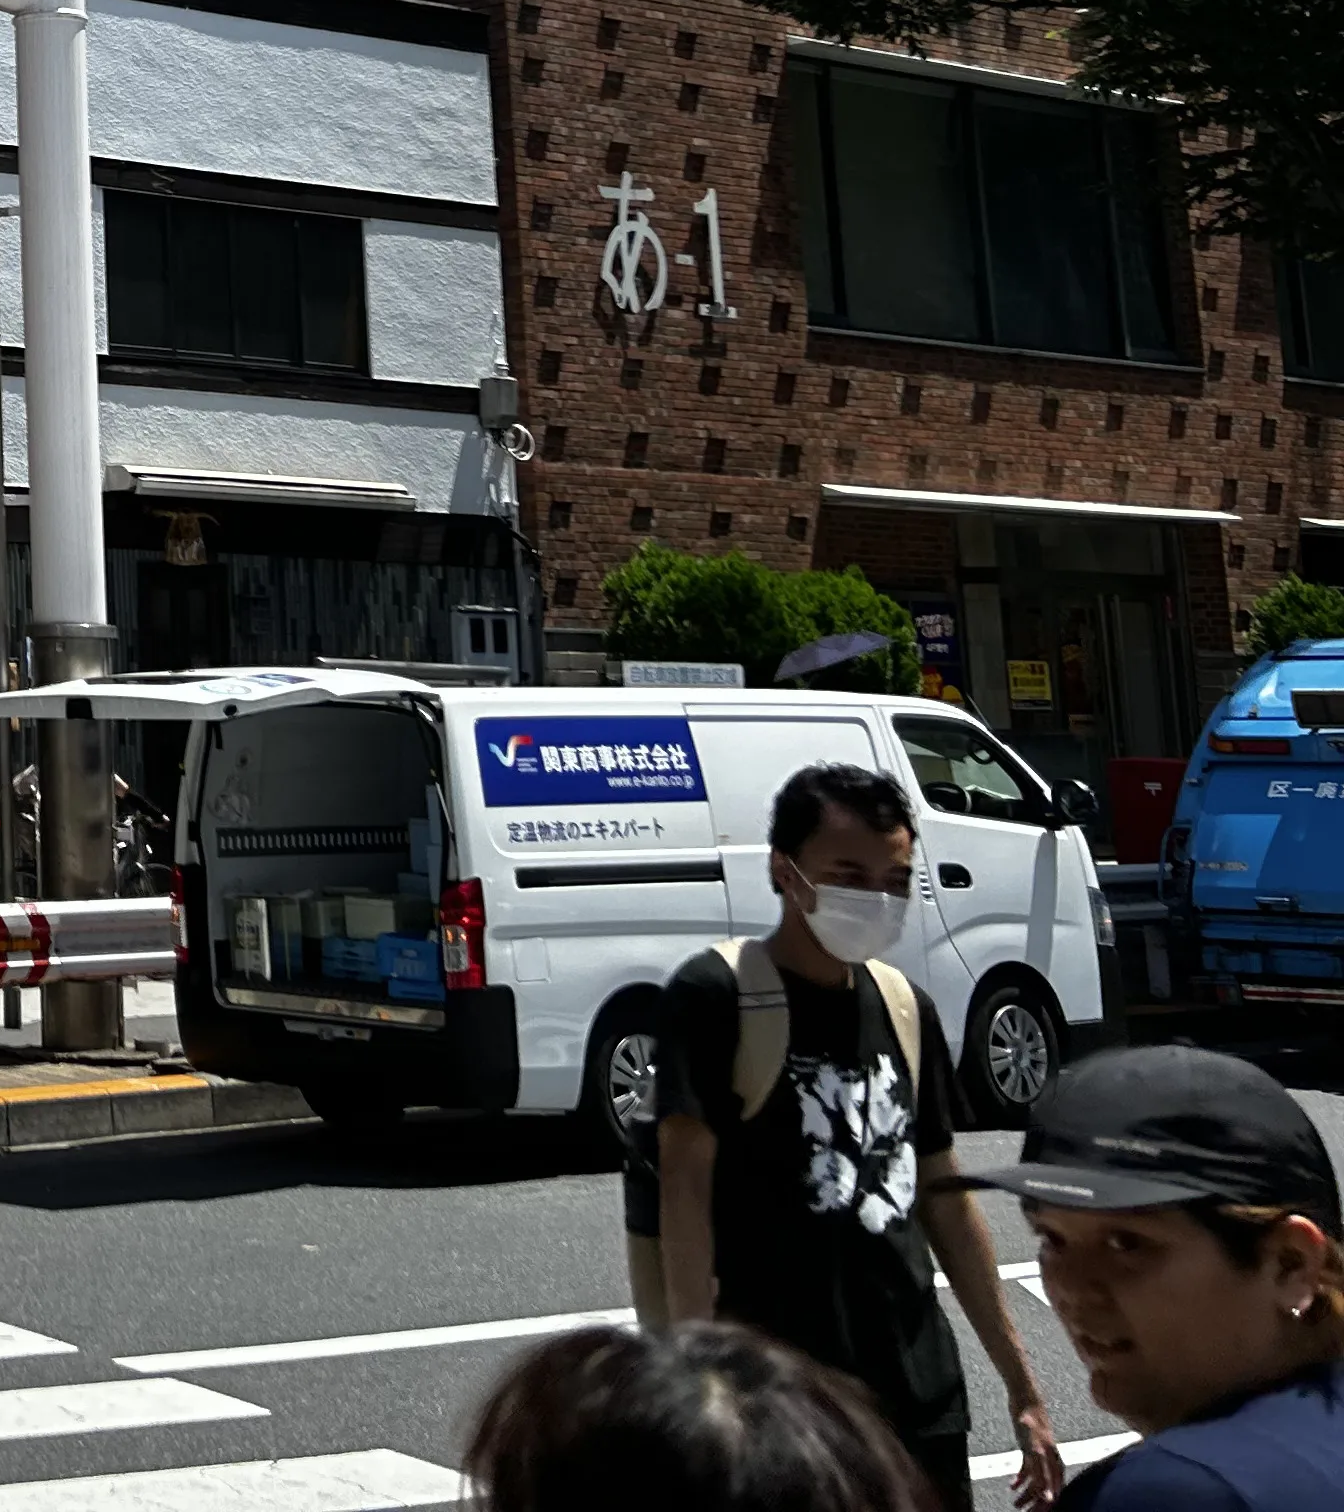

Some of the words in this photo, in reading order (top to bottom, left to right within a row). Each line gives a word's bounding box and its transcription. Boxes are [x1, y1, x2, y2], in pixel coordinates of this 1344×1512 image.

[539, 744, 691, 774] 関東商事株式会社
[1267, 780, 1344, 799] 区一廃
[507, 816, 666, 843] 定温物流のエキスパート
